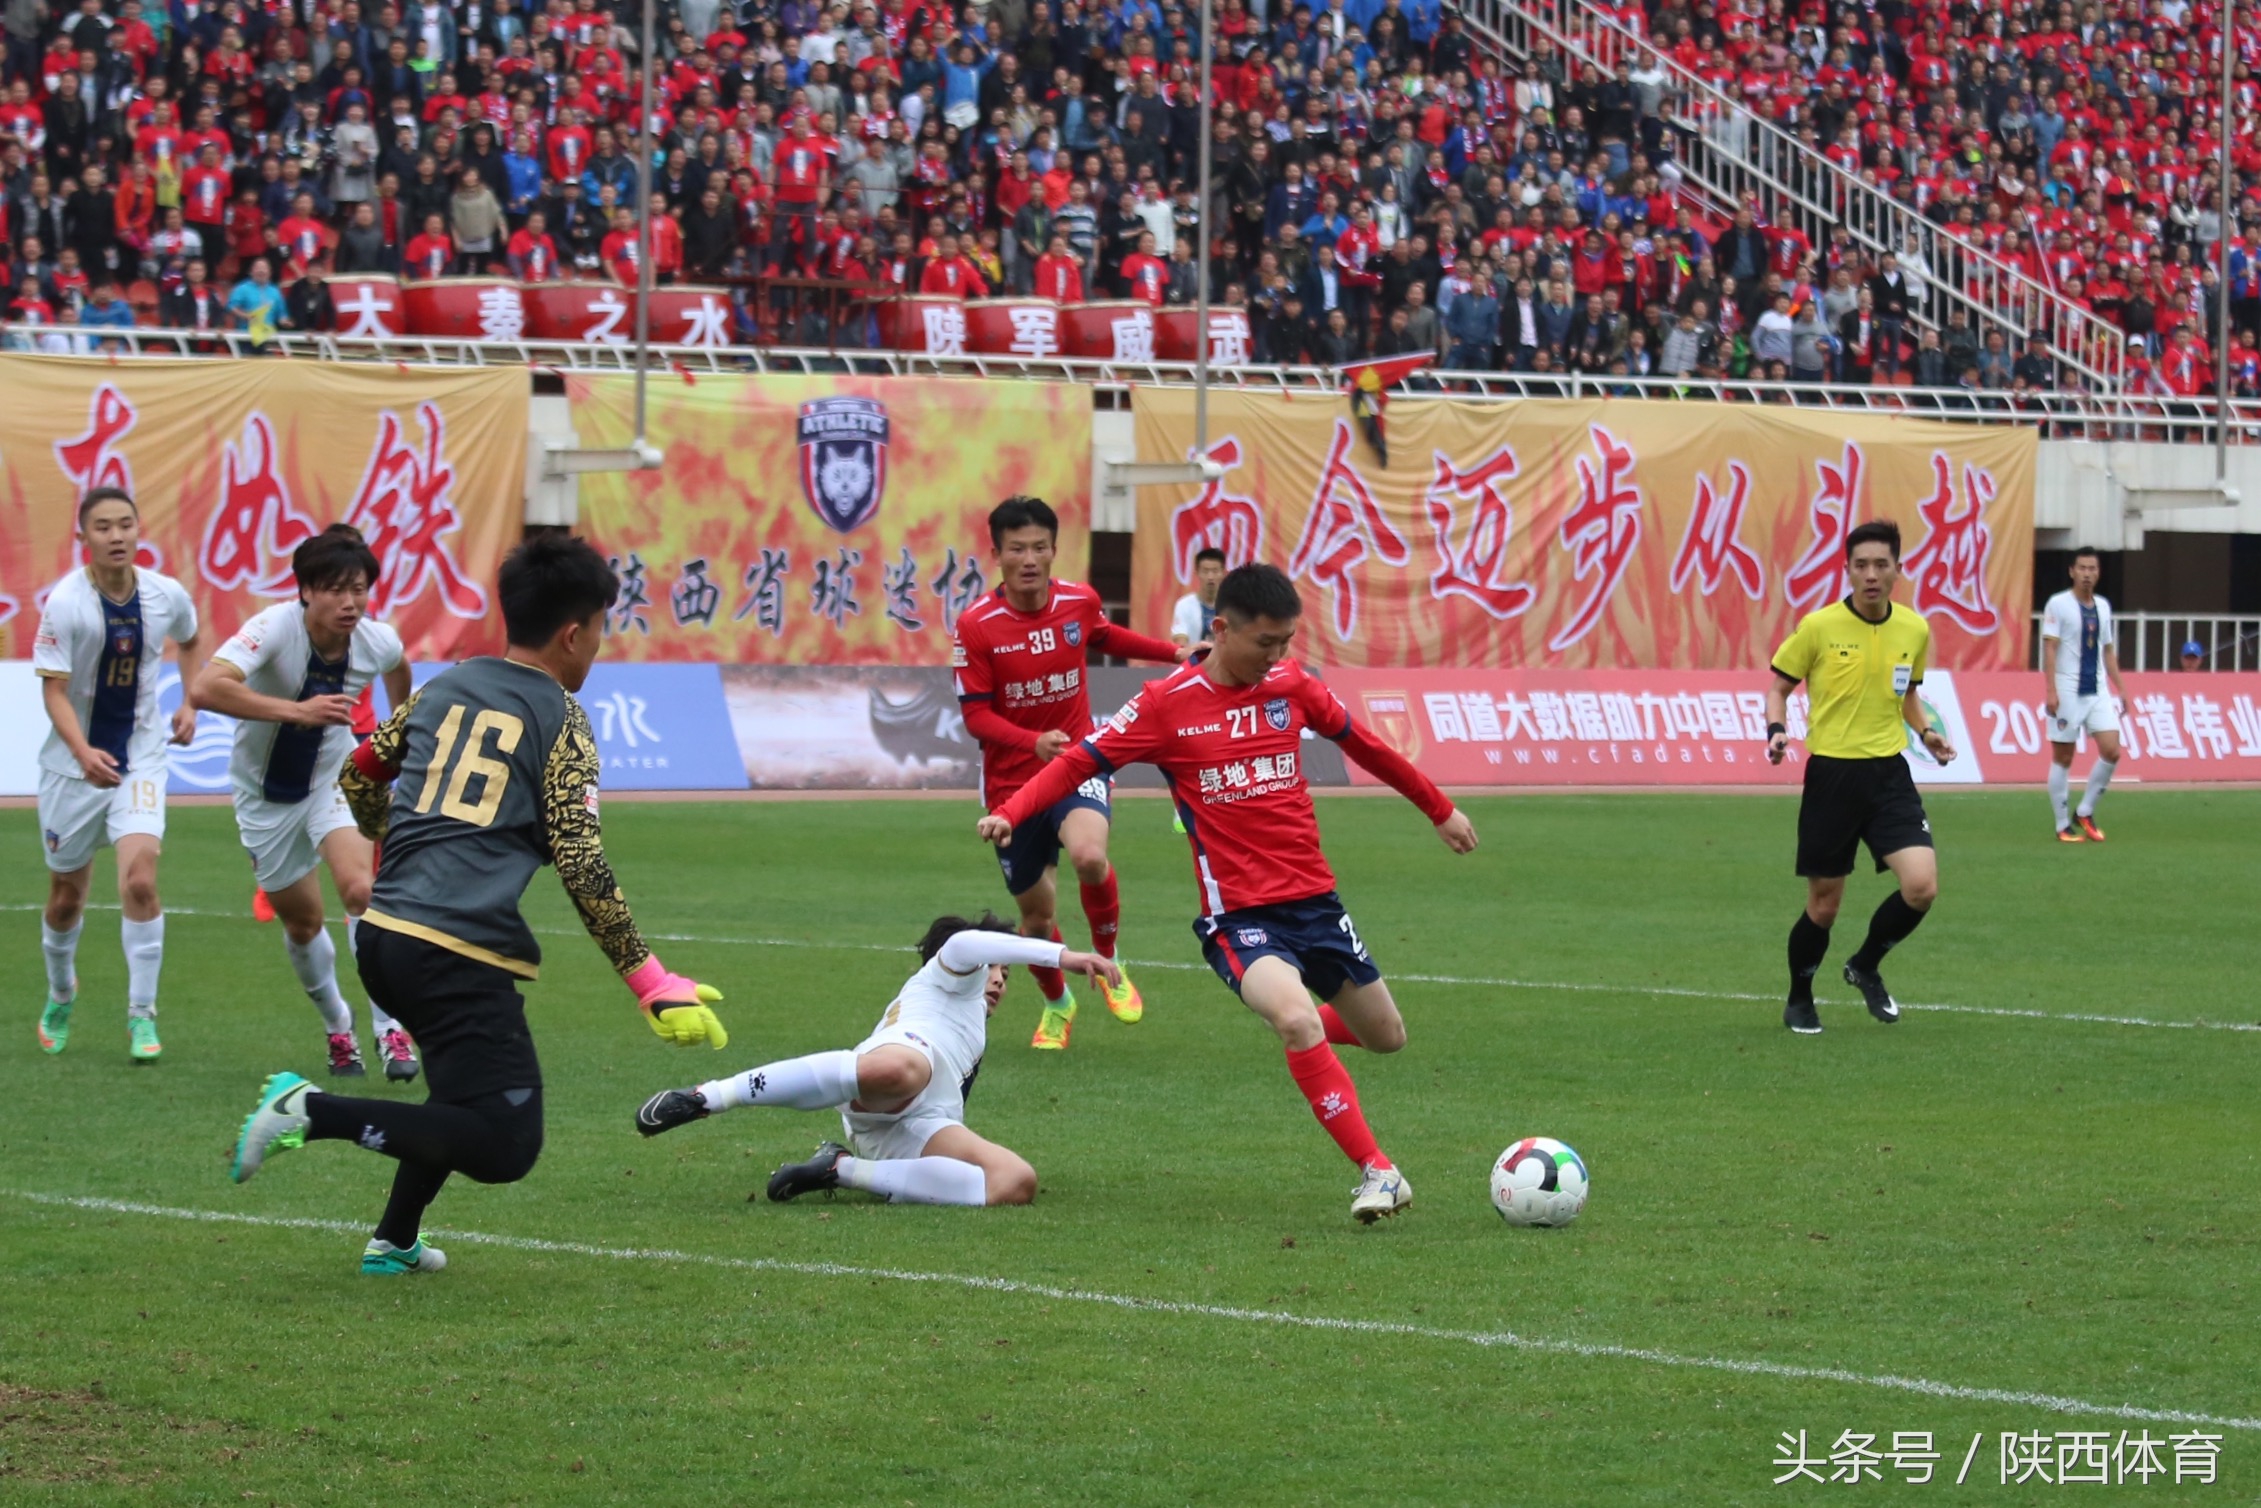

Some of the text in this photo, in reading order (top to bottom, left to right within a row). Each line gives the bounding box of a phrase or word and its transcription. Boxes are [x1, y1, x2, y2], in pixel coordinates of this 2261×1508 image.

[994, 628, 1056, 655] KELME 39
[106, 657, 136, 687] 19
[1056, 686, 1081, 702] GROUP
[1177, 724, 1221, 737] KELME
[1226, 705, 1257, 739] 27
[414, 704, 524, 828] 16
[599, 757, 669, 768] ATER
[131, 779, 156, 809] 19
[1203, 777, 1300, 805] GREENLAND GROUP
